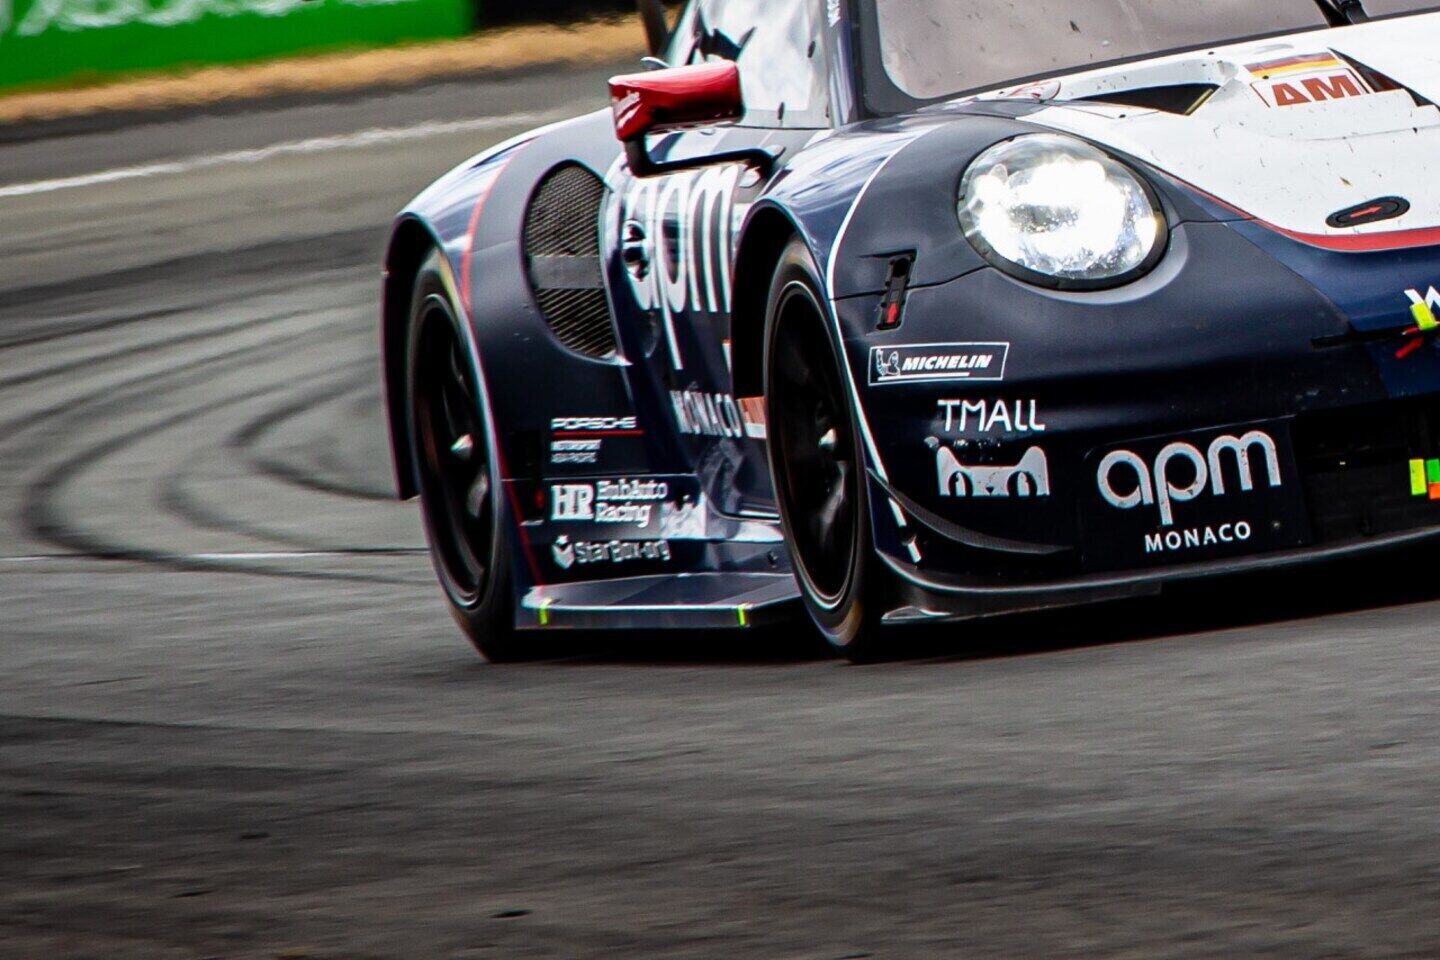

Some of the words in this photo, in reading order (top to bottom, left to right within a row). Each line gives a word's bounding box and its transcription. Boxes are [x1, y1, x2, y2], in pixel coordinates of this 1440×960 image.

[1271, 74, 1361, 107] AM
[901, 354, 993, 371] MICHELIN
[550, 416, 637, 430] PORSCHE
[937, 398, 1046, 432] TMALL
[1096, 430, 1282, 526] apm
[595, 501, 653, 528] Racing
[1144, 521, 1251, 553] MONACO
